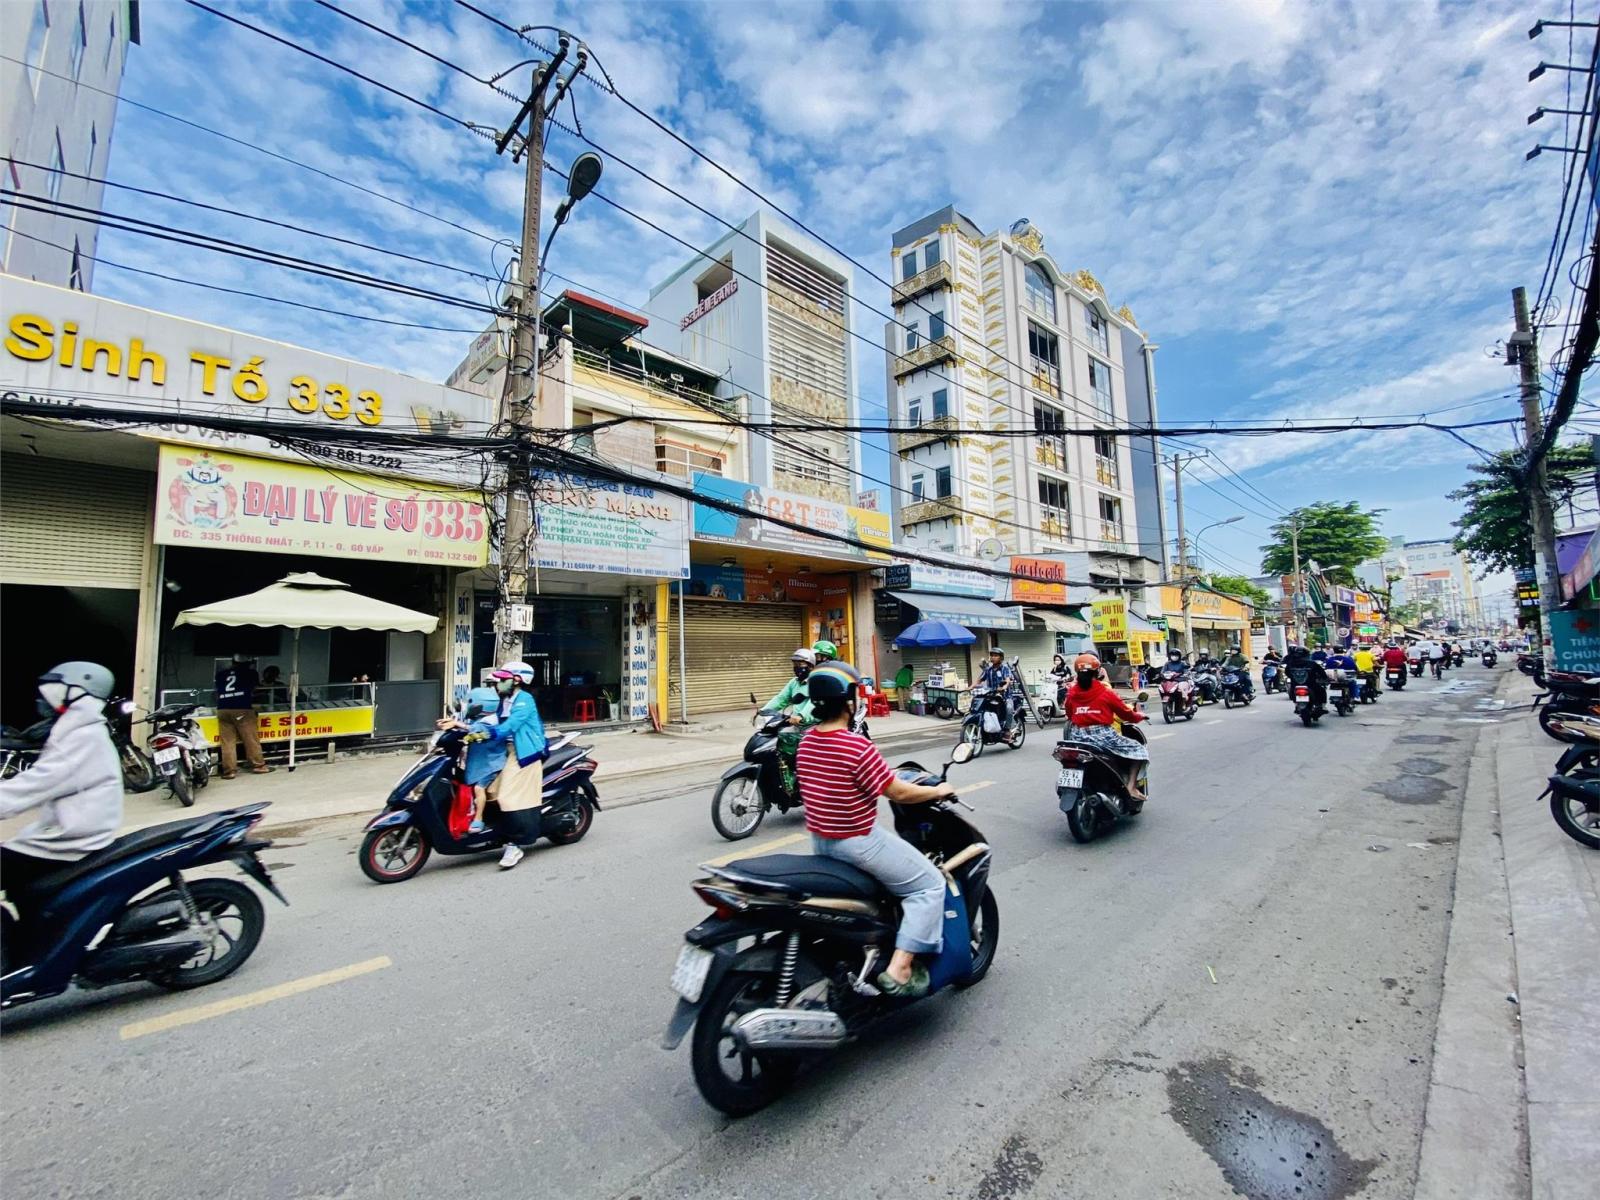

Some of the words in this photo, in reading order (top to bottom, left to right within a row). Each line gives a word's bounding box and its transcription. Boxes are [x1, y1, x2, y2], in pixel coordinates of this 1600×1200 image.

[4, 313, 168, 386] Sinh
[190, 351, 269, 404] Tố
[287, 373, 384, 427] 333
[369, 452, 403, 470] 2222
[243, 481, 298, 526] ĐẠI
[304, 484, 339, 524] LÝ
[384, 493, 420, 533] SỐ
[424, 498, 484, 542] 335
[606, 496, 672, 521] MẠNH
[766, 496, 810, 530] C&T
[815, 506, 832, 521] PET
[815, 519, 838, 530] SHOP
[200, 531, 222, 542] 335
[315, 541, 326, 550] 11
[424, 551, 444, 560] 0932
[447, 553, 461, 562] 132
[1106, 630, 1125, 641] CHAY
[633, 642, 646, 655] SẢN
[225, 674, 237, 691] 2
[631, 673, 648, 686] CÔNG
[278, 712, 308, 726] SỐ
